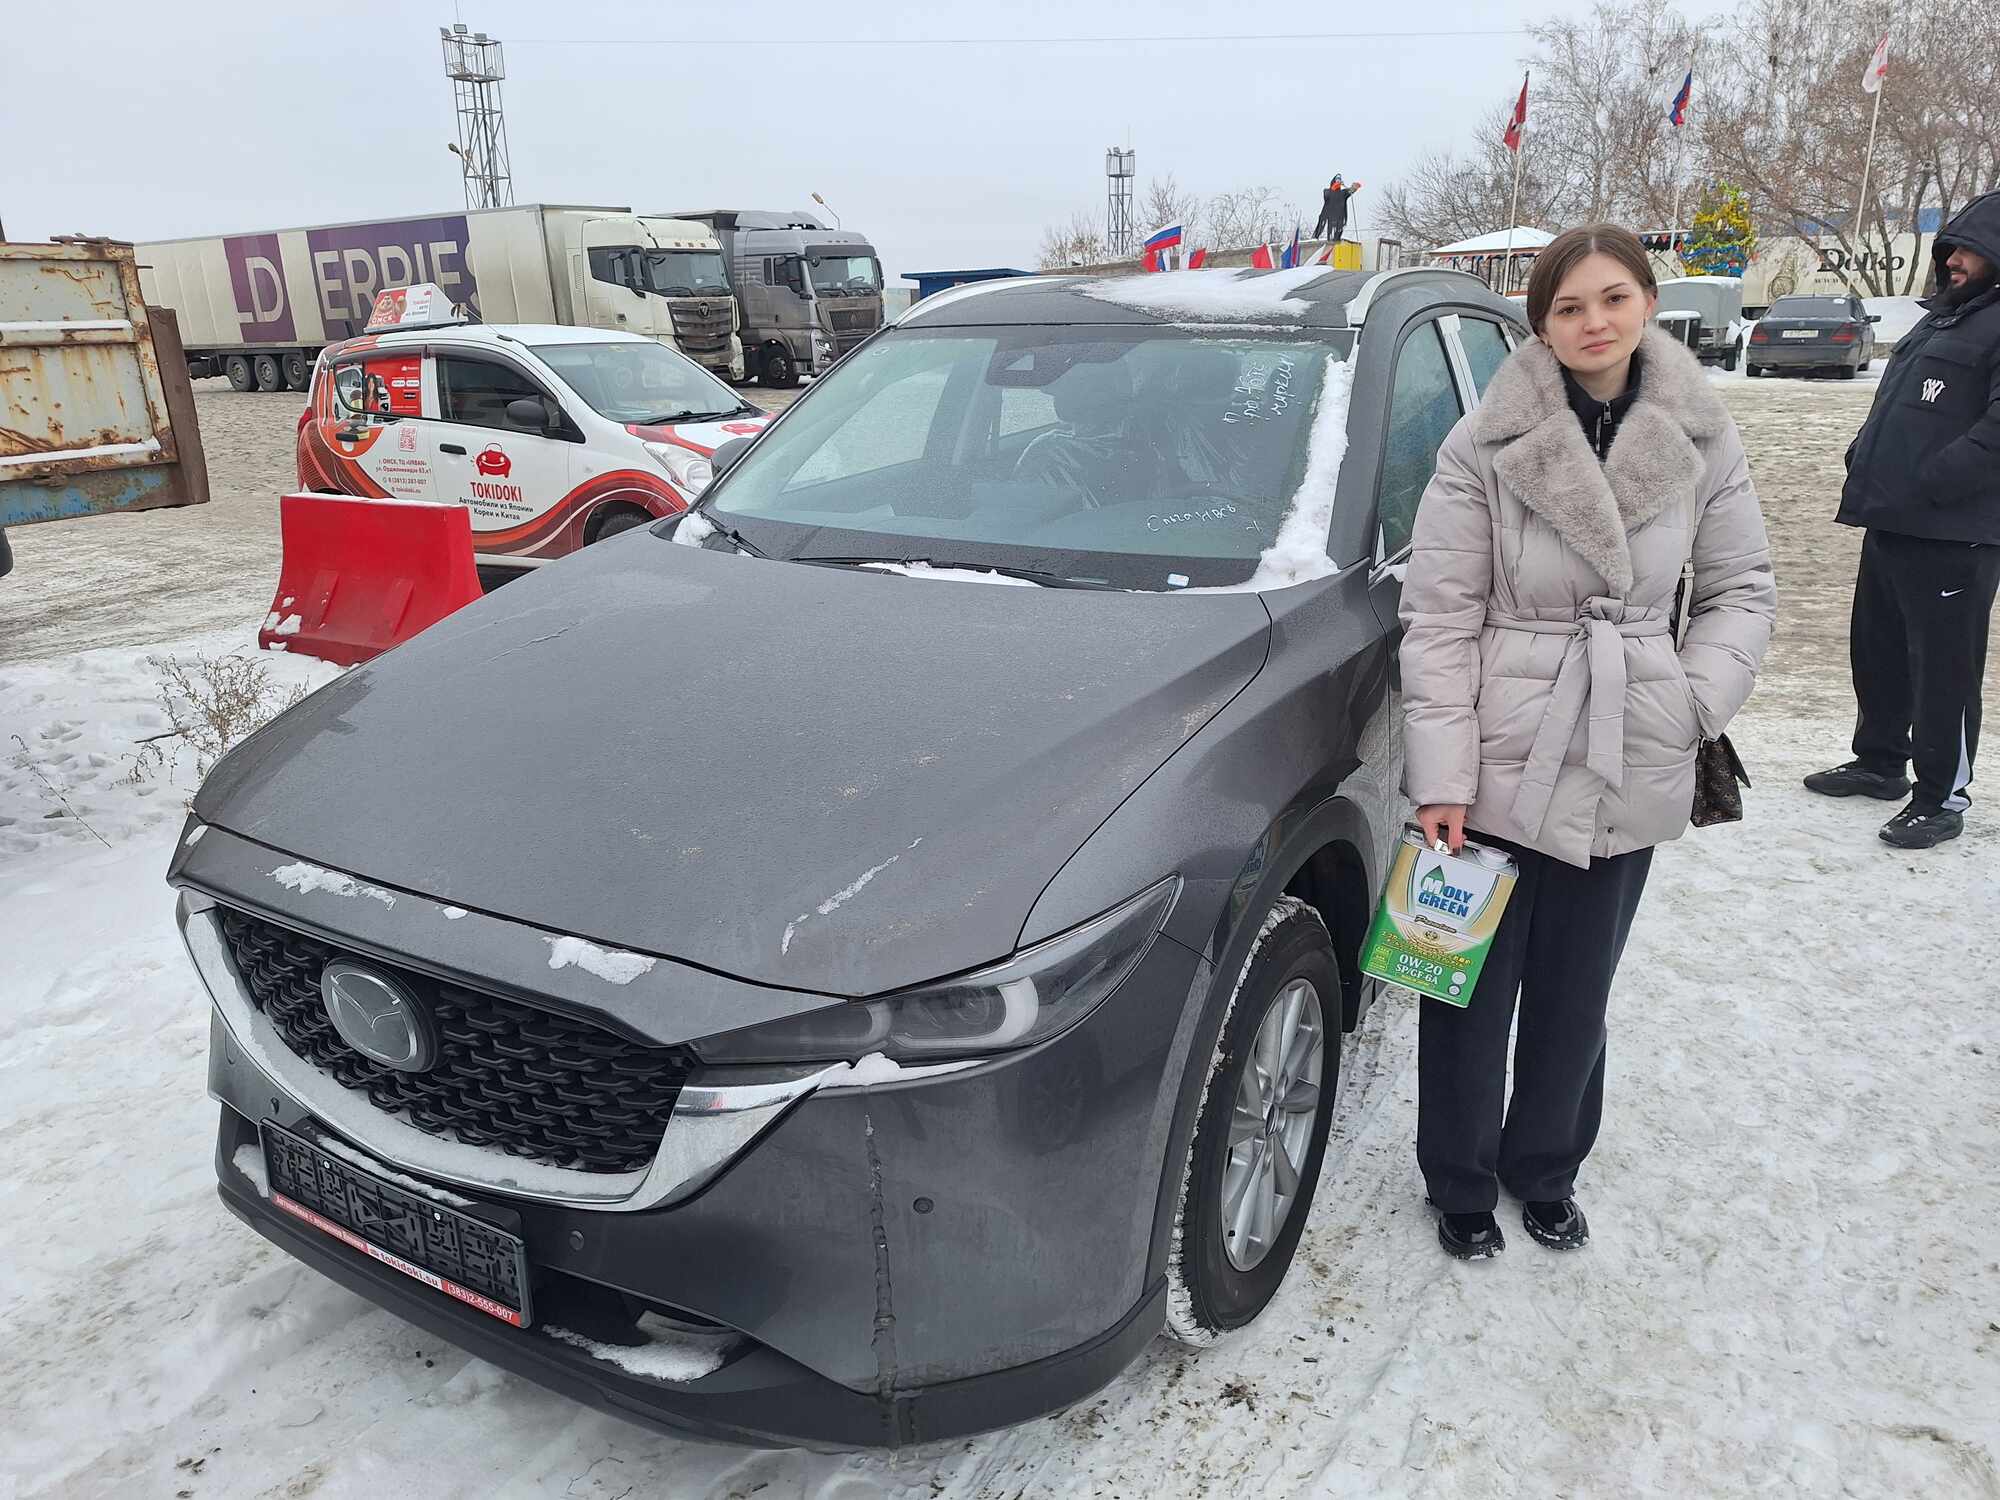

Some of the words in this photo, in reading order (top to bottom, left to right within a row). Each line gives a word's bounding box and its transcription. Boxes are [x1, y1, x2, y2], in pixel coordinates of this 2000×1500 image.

[313, 240, 482, 320] ERRIE
[470, 482, 523, 502] TOKIDOKI
[458, 496, 499, 508] Автомобили
[508, 503, 534, 513] Японии
[501, 511, 521, 520] Китая
[1423, 876, 1475, 904] MOLY
[1418, 892, 1469, 918] GREEN
[1396, 963, 1438, 985] SP/GF-6A
[1400, 953, 1443, 976] 0W-20
[380, 1252, 439, 1287] tokidoki.su
[447, 1282, 513, 1322] (383)2-555-007
